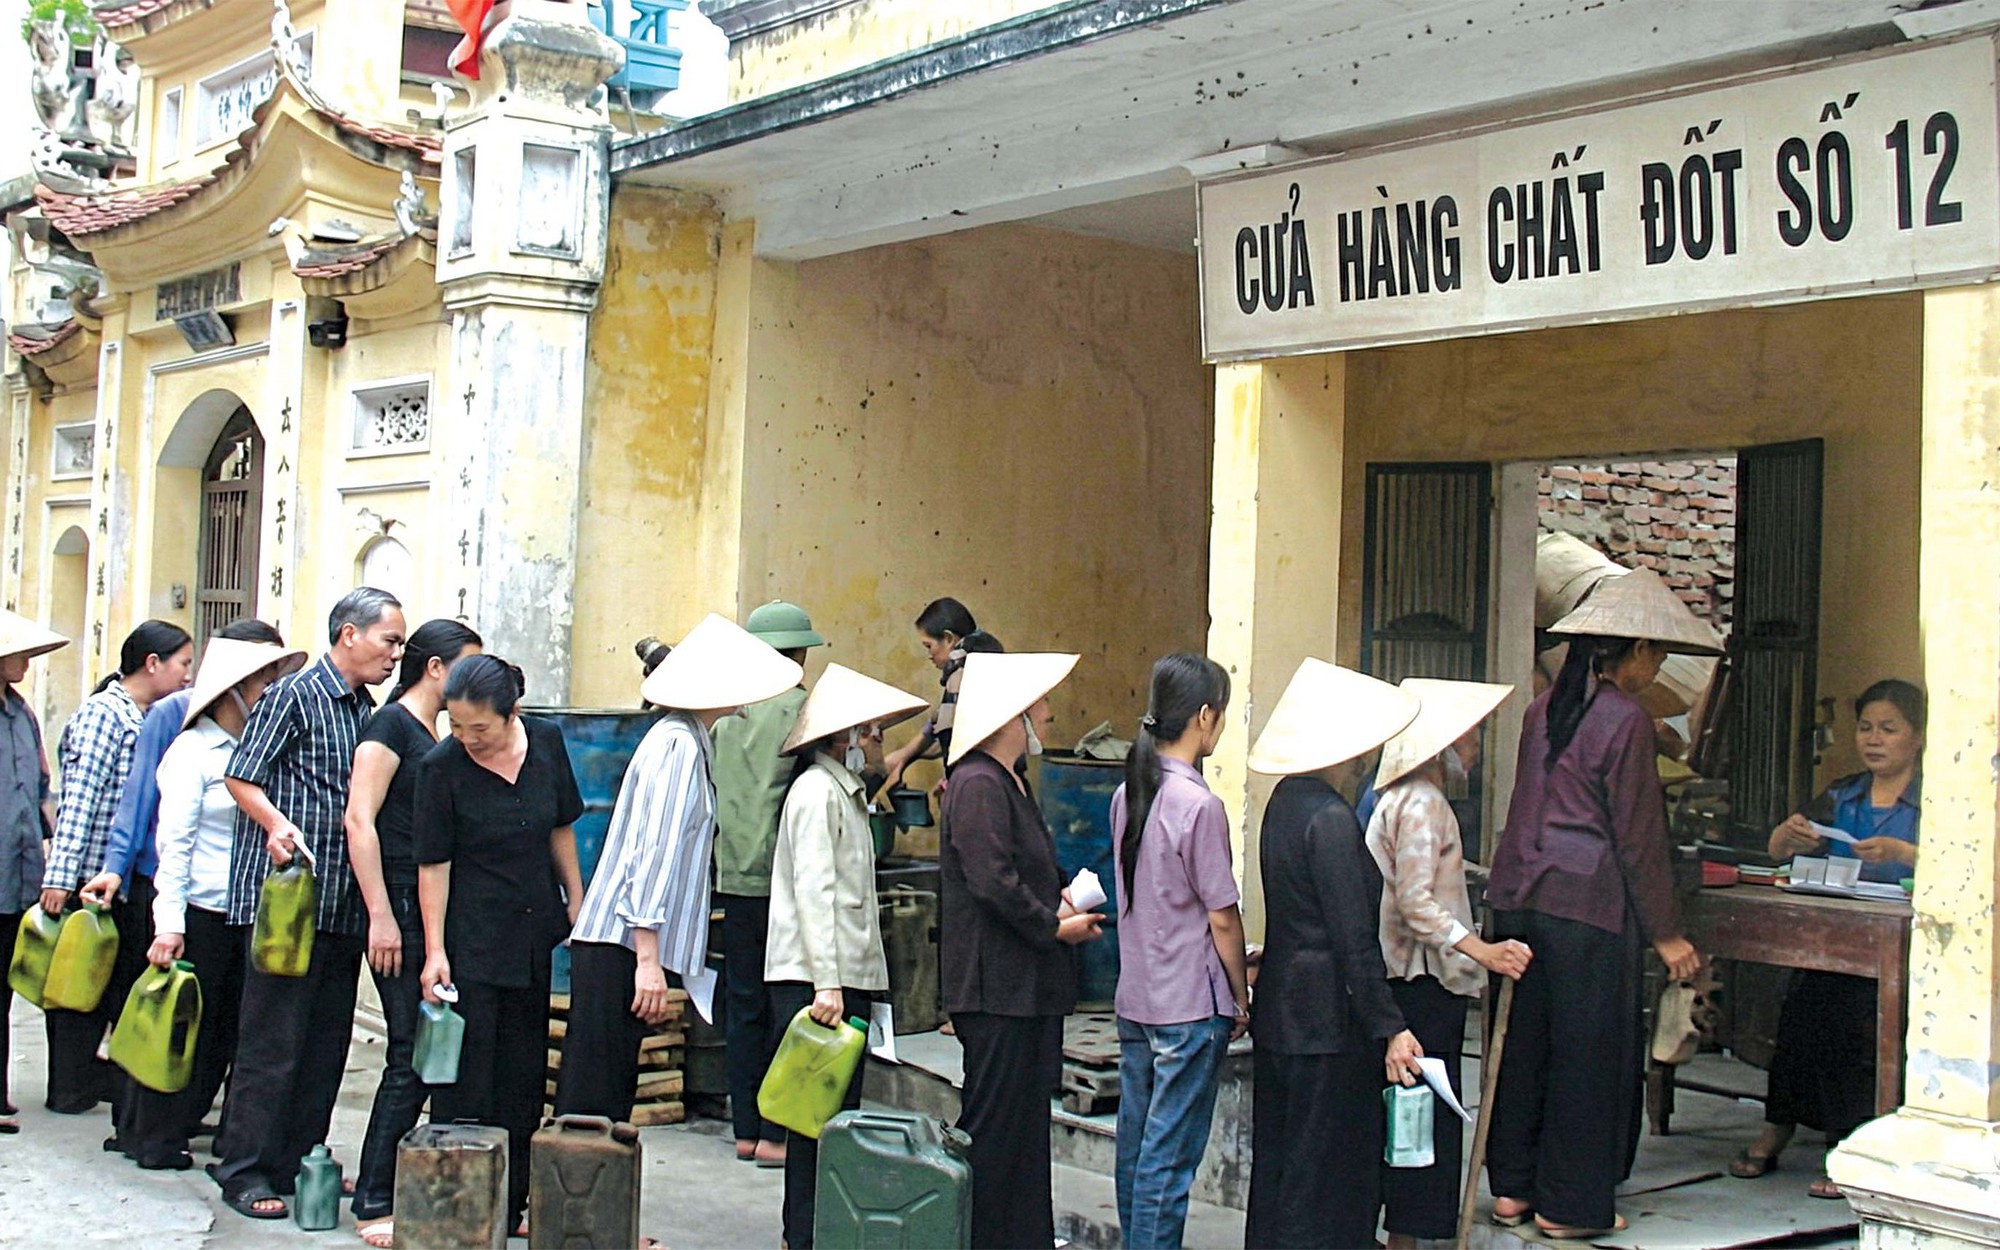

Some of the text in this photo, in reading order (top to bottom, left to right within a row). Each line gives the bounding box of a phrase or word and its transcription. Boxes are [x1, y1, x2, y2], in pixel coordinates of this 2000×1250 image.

[1337, 185, 1461, 303] HÀNG
[1487, 145, 1605, 285] CHẤT
[1640, 119, 1743, 266] ĐỐT
[1776, 92, 1860, 247] SỐ
[1886, 111, 1963, 230] 12
